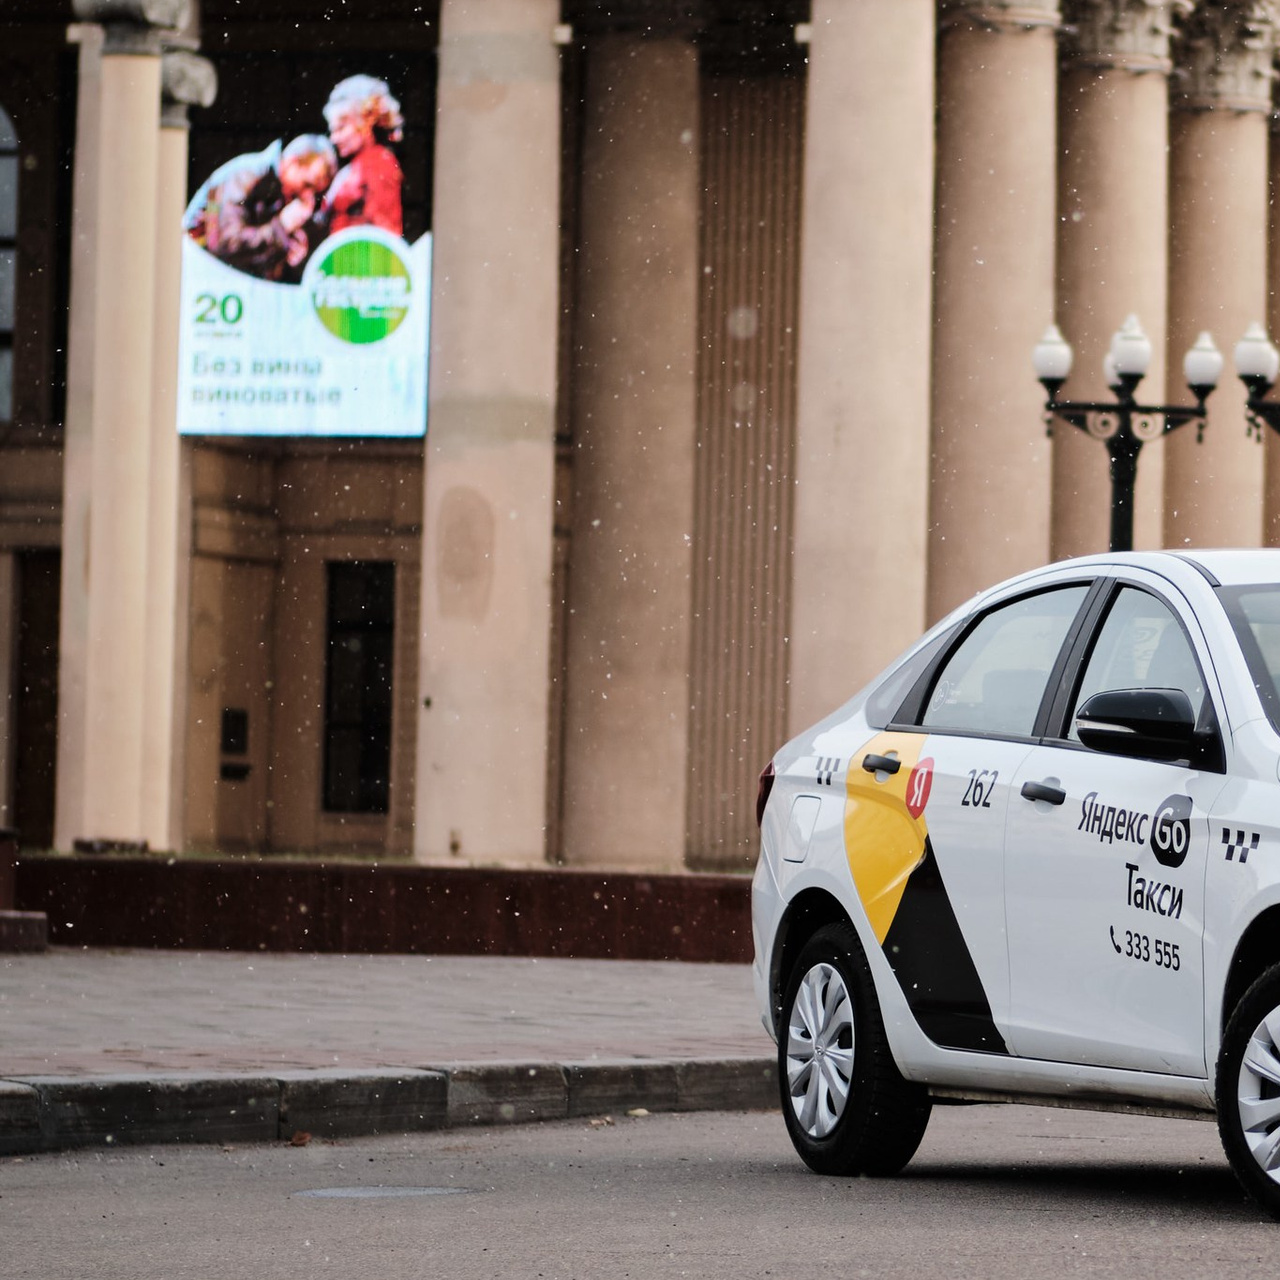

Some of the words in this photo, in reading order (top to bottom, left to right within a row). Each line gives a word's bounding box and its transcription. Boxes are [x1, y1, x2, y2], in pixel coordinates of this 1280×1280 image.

[195, 293, 243, 325] 20
[910, 767, 928, 808] Я
[961, 768, 999, 808] 262
[1078, 791, 1149, 845] Яндекс
[1154, 807, 1187, 854] Go
[1125, 862, 1184, 920] Такси
[1125, 930, 1151, 962] 333
[1155, 939, 1181, 971] 555
